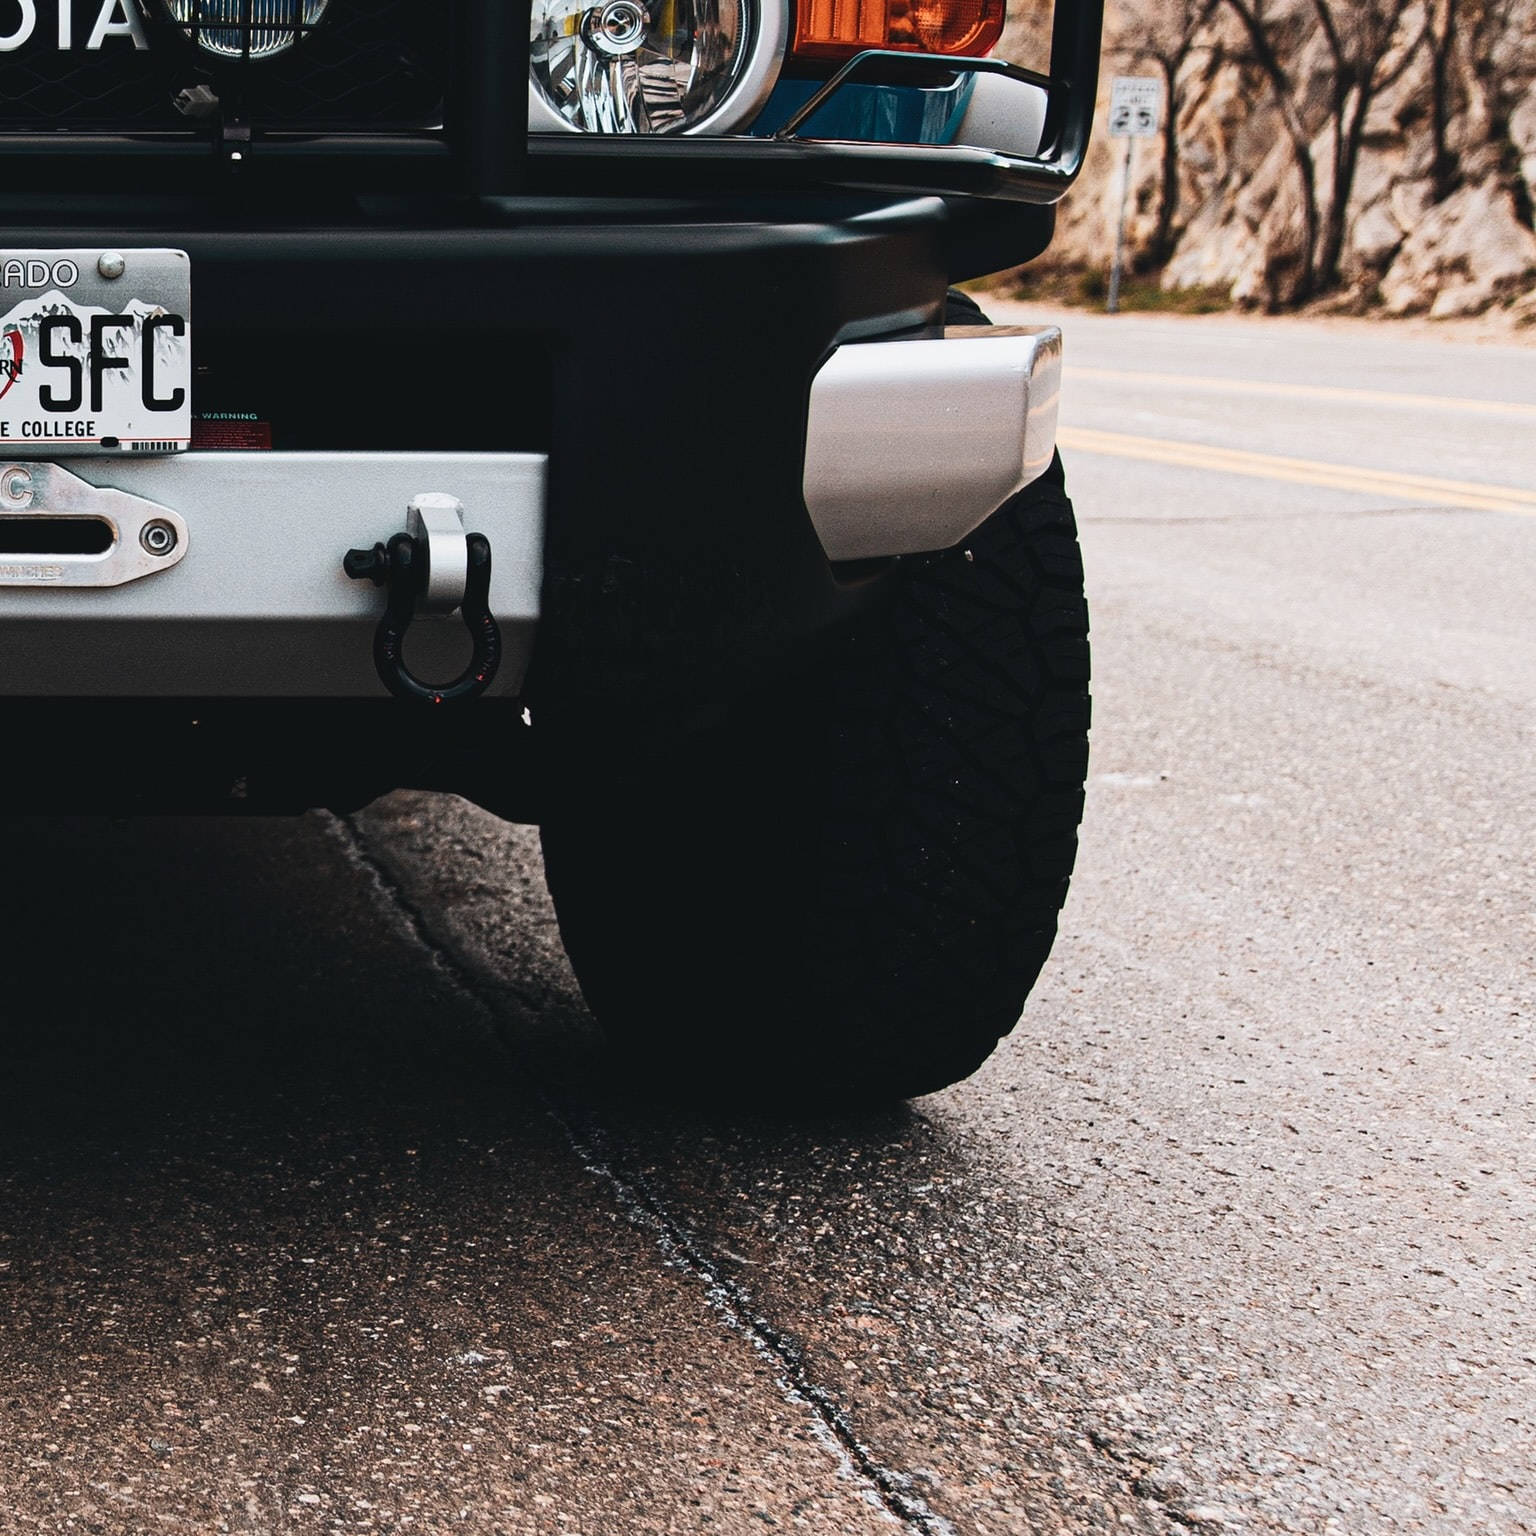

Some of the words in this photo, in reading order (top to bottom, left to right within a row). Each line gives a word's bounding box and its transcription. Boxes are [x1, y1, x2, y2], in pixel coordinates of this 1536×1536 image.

[38, 314, 185, 413] SFC
[202, 412, 258, 420] WARNING
[21, 420, 96, 438] COLLEGE
